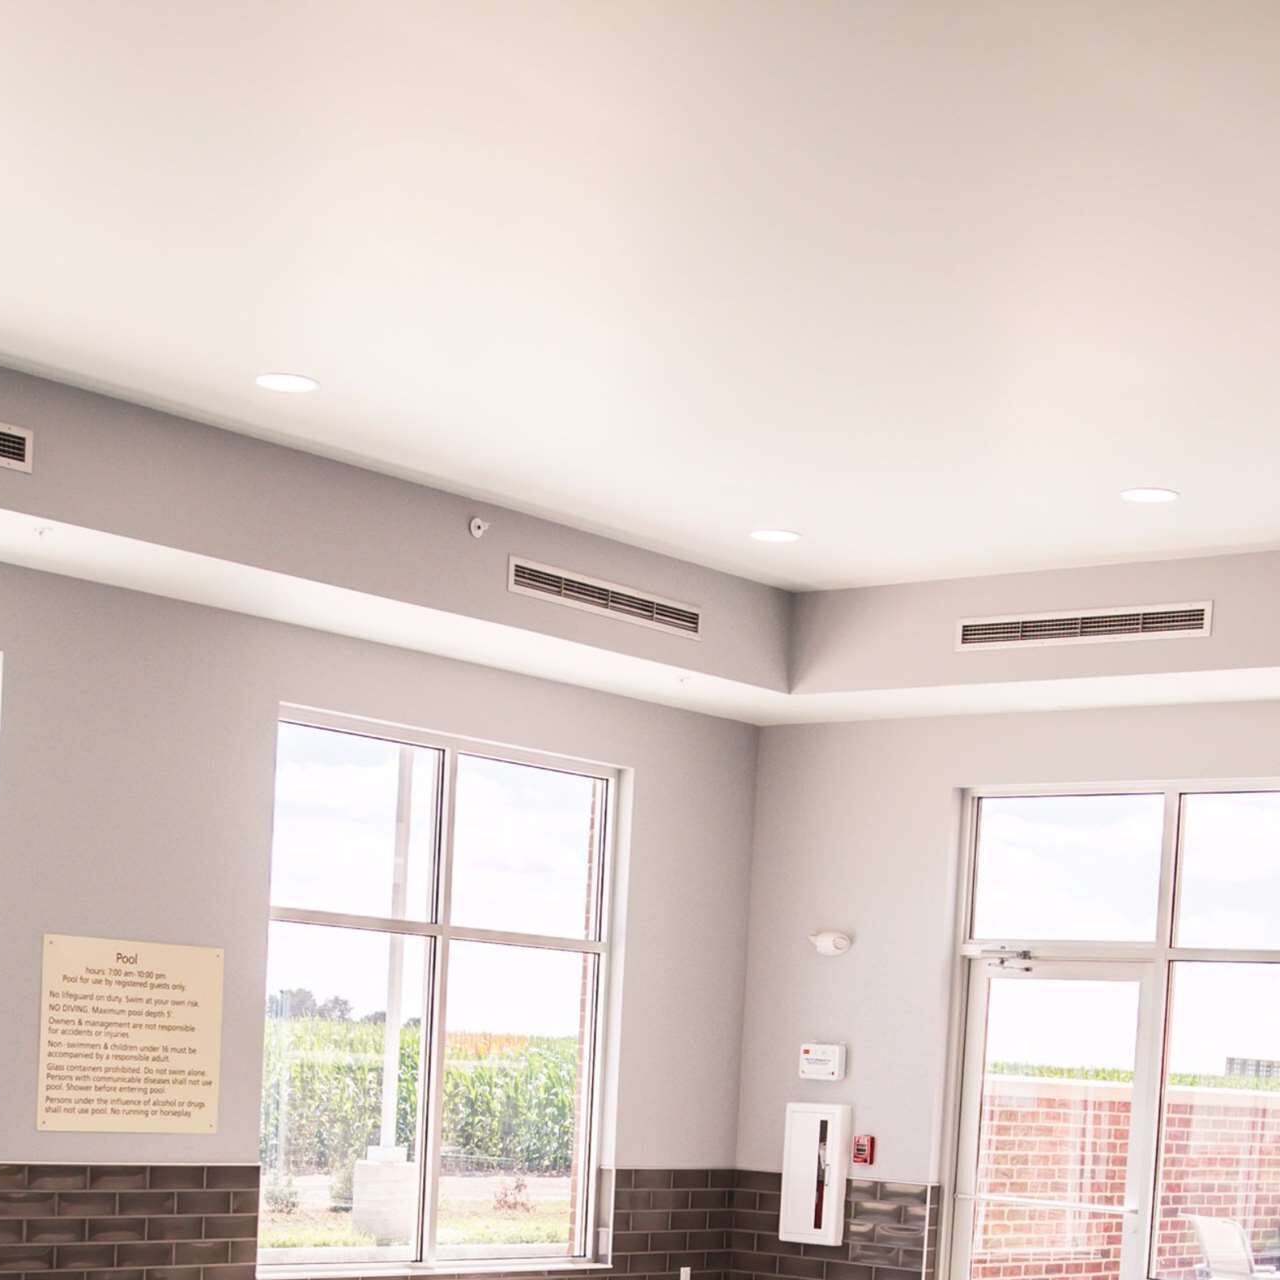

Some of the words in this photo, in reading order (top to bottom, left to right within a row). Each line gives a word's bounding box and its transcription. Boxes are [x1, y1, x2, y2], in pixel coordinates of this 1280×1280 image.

[116, 952, 138, 964] Pool
[62, 974, 78, 983] Pool
[80, 976, 89, 984] for
[105, 977, 113, 987] by
[115, 979, 148, 989] registered
[149, 982, 170, 990] guests
[49, 990, 60, 998] No
[61, 991, 94, 1002] lifeguard
[126, 995, 144, 1003] Swim
[92, 1006, 126, 1015] Maximum
[128, 1009, 144, 1017] pool
[145, 1009, 165, 1018] depth
[48, 1016, 76, 1025] Owners
[78, 1018, 83, 1026] &
[85, 1020, 130, 1030] management
[158, 1024, 196, 1032] responsible
[48, 1026, 58, 1034] for
[103, 1042, 108, 1050] &
[110, 1043, 137, 1051] children
[188, 1046, 197, 1054] be
[48, 1051, 94, 1059] accompanied
[96, 1052, 103, 1062] by
[46, 1063, 65, 1071] Glass
[46, 1073, 73, 1081] Persons
[144, 1076, 170, 1084] diseases
[66, 1082, 92, 1091] Shower
[94, 1084, 117, 1092] before
[118, 1086, 148, 1095] entering
[46, 1096, 72, 1104] Persons
[187, 1100, 205, 1110] drugs
[45, 1105, 61, 1113] shall
[110, 1107, 120, 1115] No
[122, 1109, 149, 1117] running
